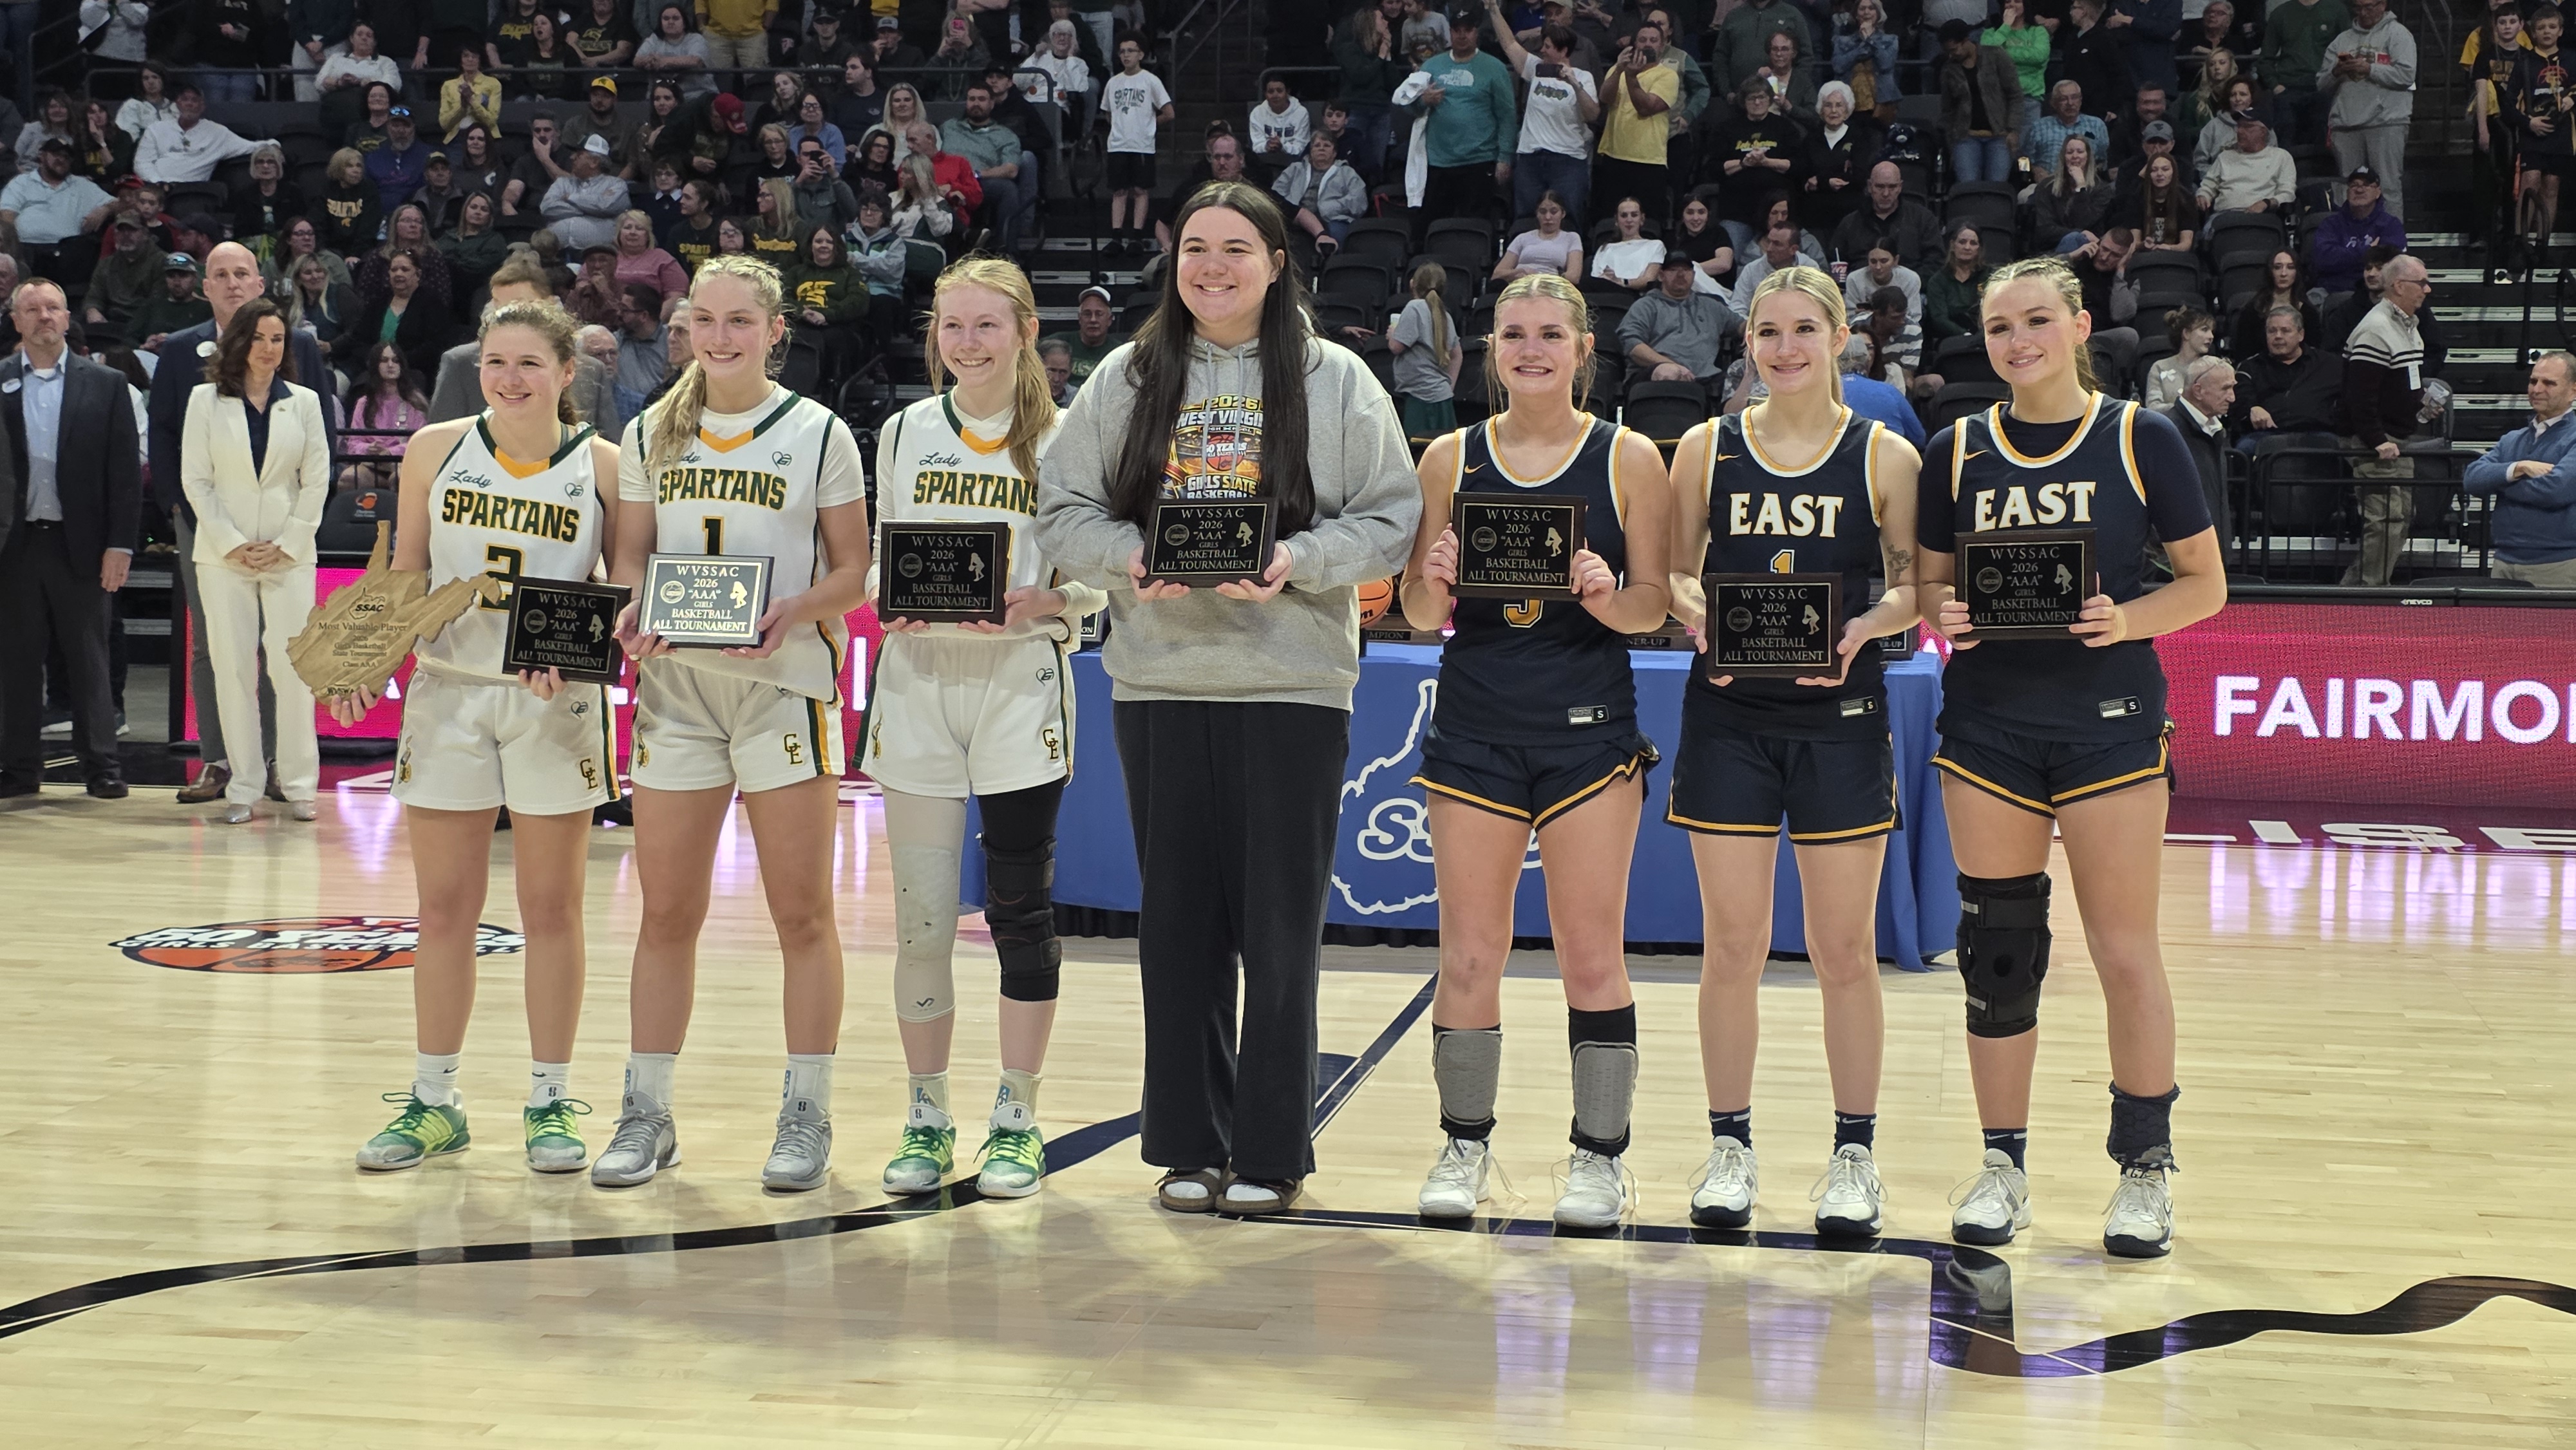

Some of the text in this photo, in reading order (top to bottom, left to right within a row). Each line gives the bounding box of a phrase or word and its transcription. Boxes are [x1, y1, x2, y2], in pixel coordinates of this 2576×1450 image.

[1209, 395, 1258, 410] 2026
[919, 451, 963, 467] Lady
[449, 469, 493, 489] Lady
[658, 467, 787, 512] SPARTANS
[1181, 508, 1245, 518] WVSSAC
[1974, 481, 2096, 533] EAST
[441, 487, 581, 544] SPARTANS
[1486, 509, 1551, 522] WVSSAC
[1729, 493, 1843, 538] EAST
[1198, 520, 1223, 529] 2026
[1506, 523, 1531, 534] 2026
[702, 515, 724, 554] 1
[912, 536, 974, 547] WVSSAC
[931, 550, 955, 560] 2026
[1177, 549, 1238, 559] BASKETBALL
[1990, 547, 2060, 560] WVSSAC
[1158, 560, 1255, 570] ALL TOURNAMENT
[1486, 558, 1549, 570] BASKETBALL
[2012, 563, 2038, 573] 2026
[676, 565, 739, 577] WVSSAC
[1468, 570, 1565, 583] ALL TOURNAMENT
[693, 578, 718, 588] 2026
[912, 583, 972, 594] BASKETBALL
[1741, 588, 1808, 600] WVSSAC
[538, 592, 598, 609] WVSSAC
[895, 596, 988, 607] ALL TOURNAMENT
[1992, 598, 2060, 610] BASKETBALL
[355, 604, 384, 612] SSAC
[554, 608, 578, 619] 2026
[672, 608, 733, 619] BASKETBALL
[1761, 603, 1786, 613] 2026
[1974, 611, 2078, 623] ALL TOURNAMENT
[381, 623, 408, 632] Player
[652, 619, 747, 632] ALL TOURNAMENT
[535, 639, 591, 654] BASKETBALL
[1741, 637, 1807, 648] BASKETBALL
[517, 650, 604, 668] ALL TOURNAMENT
[1723, 650, 1824, 661] ALL TOURNAMENT
[1597, 710, 1604, 719] S
[135, 928, 257, 942] 50
[246, 942, 511, 954] BASKETLL
